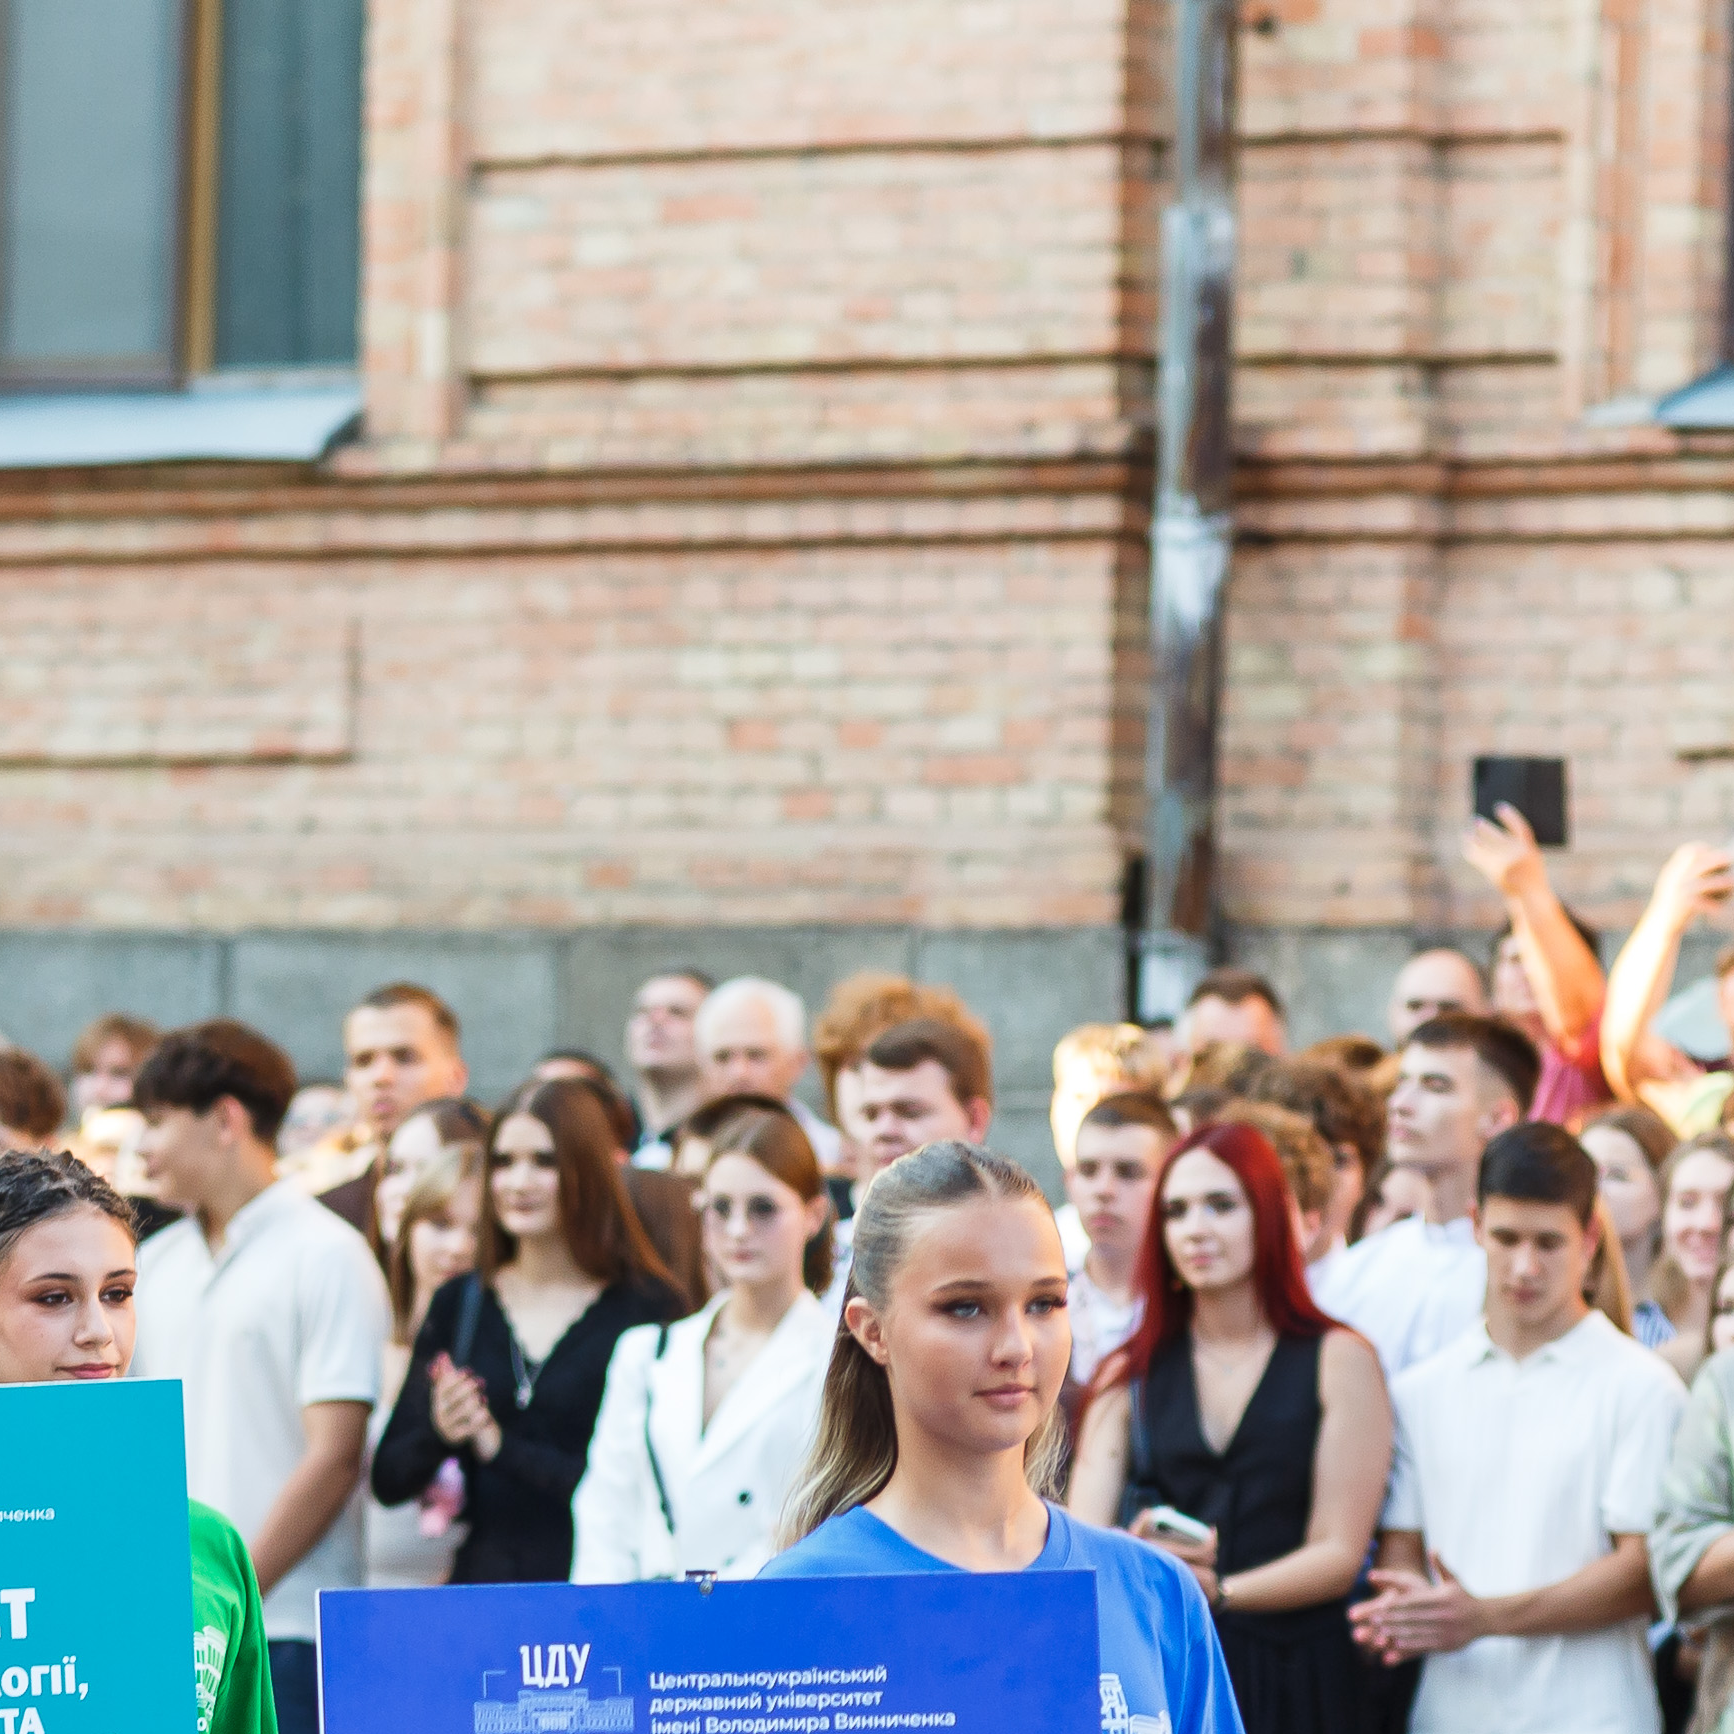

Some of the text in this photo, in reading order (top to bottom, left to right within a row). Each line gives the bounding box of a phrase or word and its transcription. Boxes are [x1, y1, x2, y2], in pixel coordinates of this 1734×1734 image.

[519, 1643, 591, 1688] ЦДУ
[649, 1665, 887, 1693] Центральноукраїнський
[650, 1688, 883, 1716] державний університет
[705, 1714, 830, 1734] Володимира
[835, 1710, 957, 1730] Винниченка
